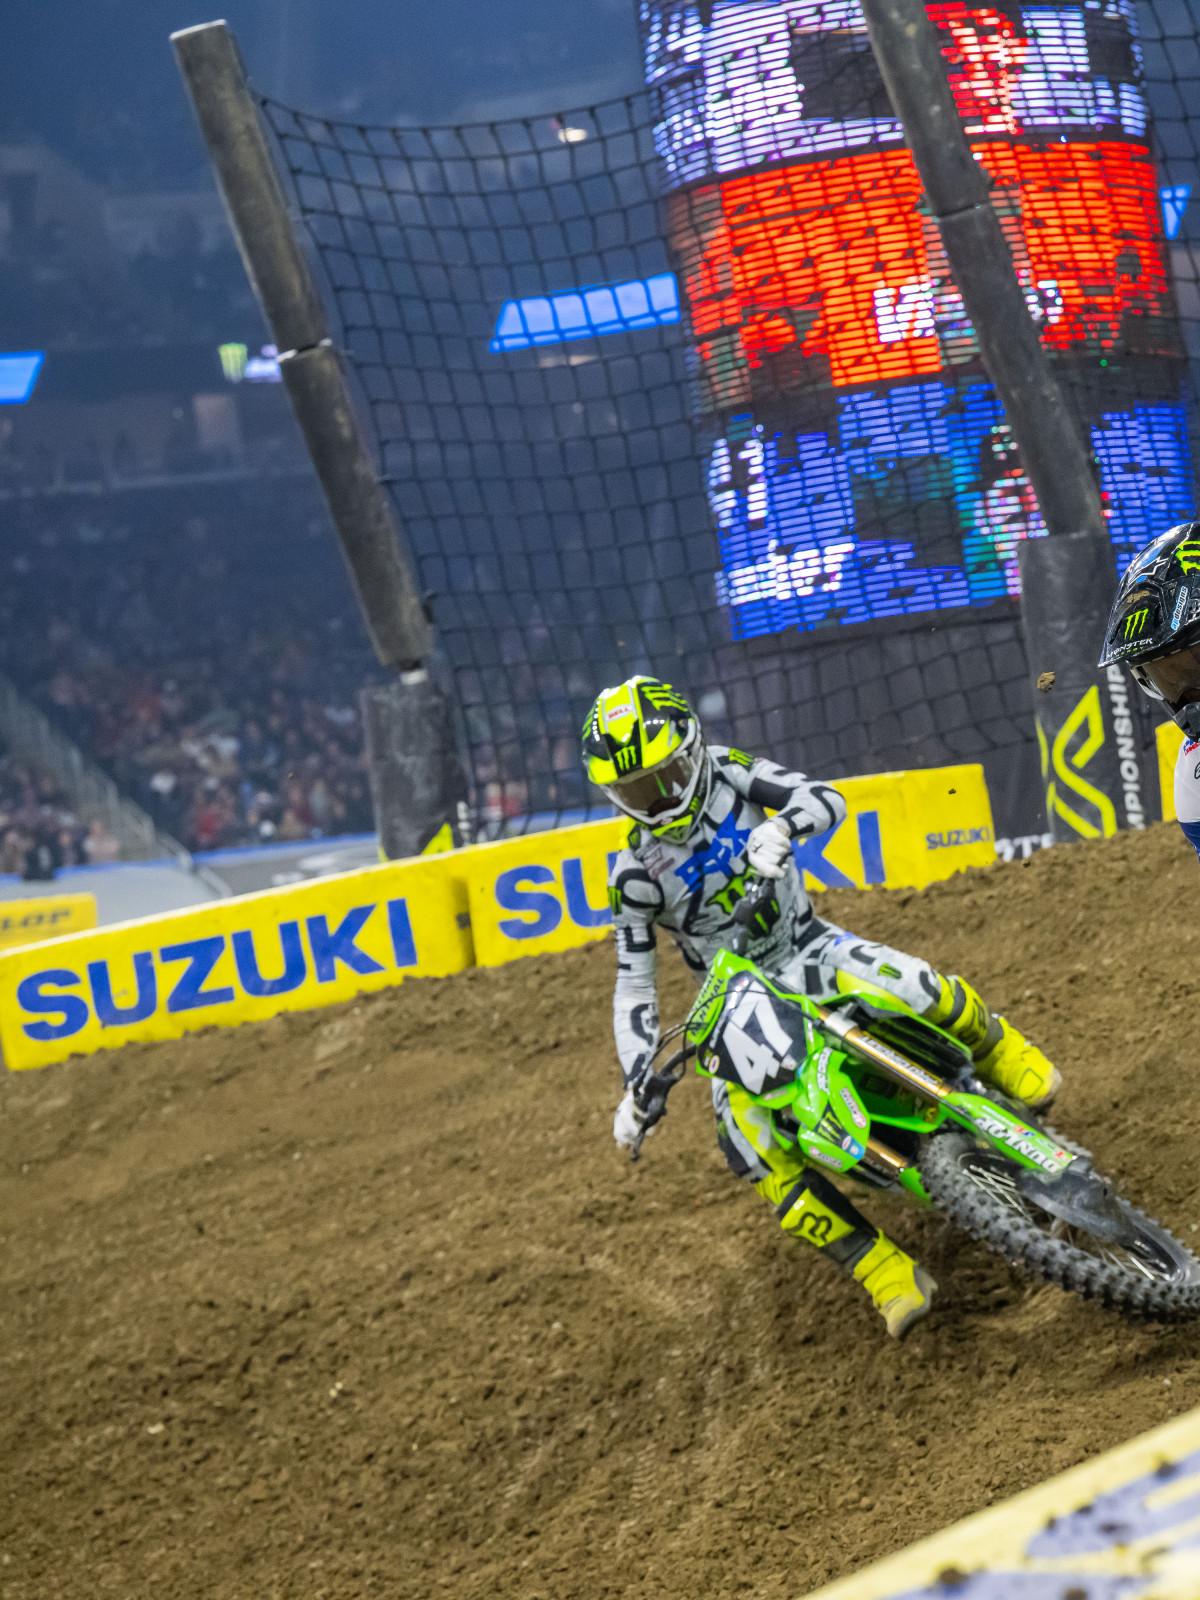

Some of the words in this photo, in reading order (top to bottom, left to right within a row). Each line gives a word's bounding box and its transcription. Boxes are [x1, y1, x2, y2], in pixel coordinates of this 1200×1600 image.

[608, 707, 629, 719] BELL
[494, 810, 886, 941] SUKI
[925, 826, 991, 850] SUZUKI
[16, 897, 418, 1042] SUZUKI
[722, 980, 793, 1095] 47
[974, 1117, 1060, 1174] DUNLOP
